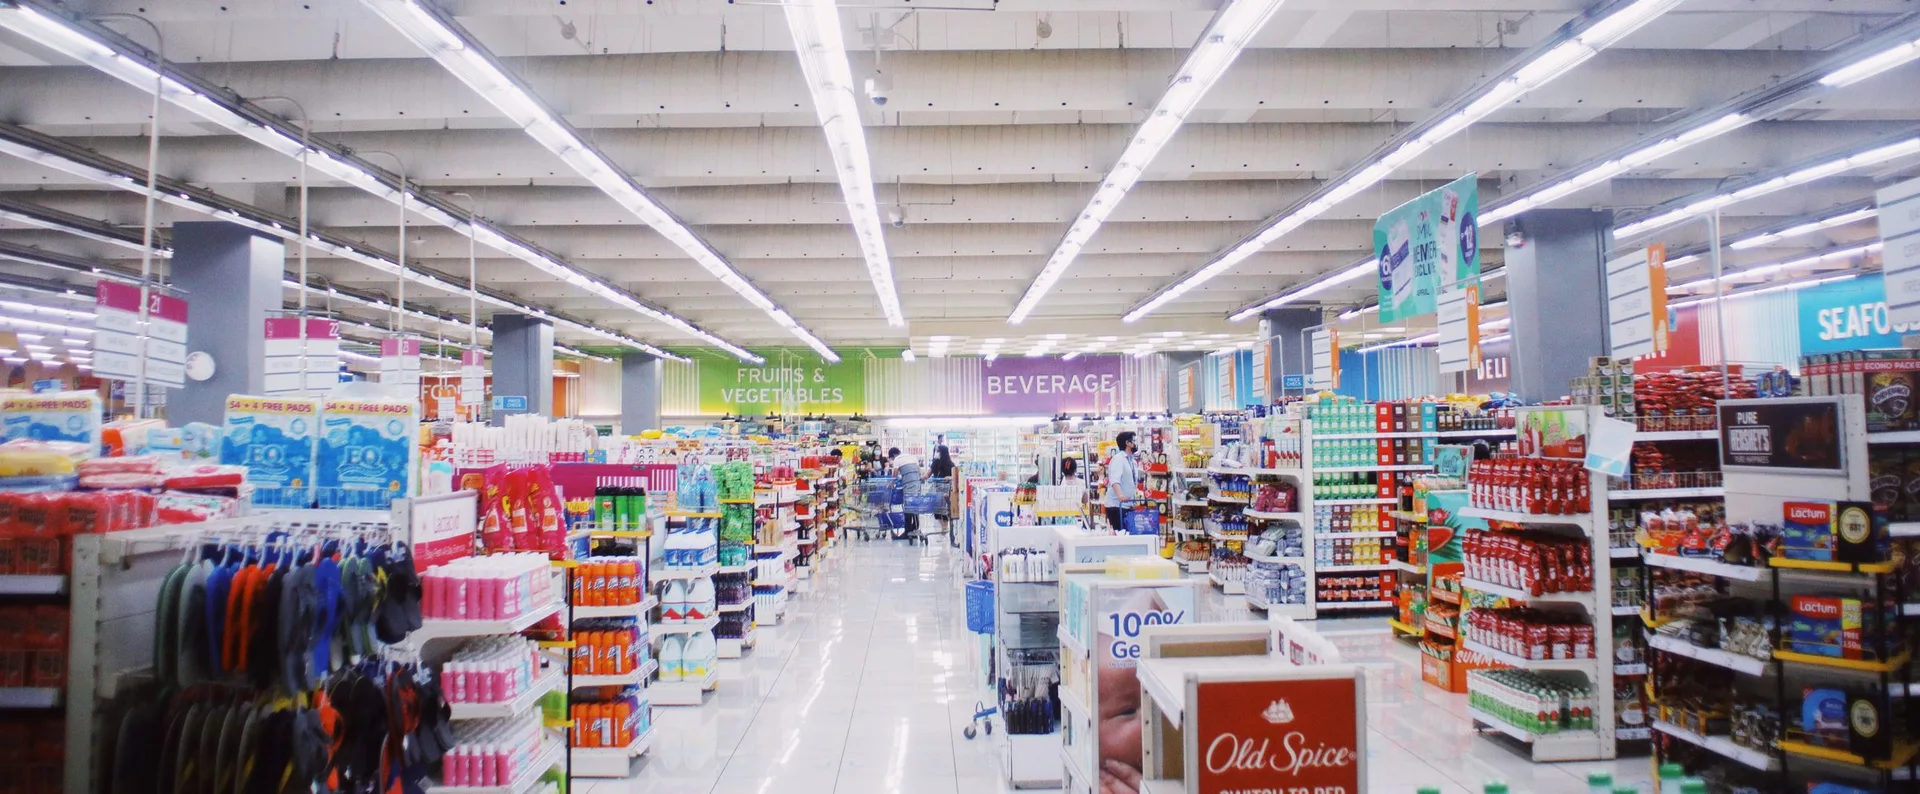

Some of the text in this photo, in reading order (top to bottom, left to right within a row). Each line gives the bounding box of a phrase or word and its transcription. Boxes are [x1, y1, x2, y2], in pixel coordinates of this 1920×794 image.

[1818, 301, 1920, 341] SEAFO
[329, 322, 339, 337] 22
[1477, 357, 1507, 381] DELI
[1864, 362, 1893, 370] ECONO
[738, 367, 825, 383] FRUITS &
[987, 373, 1114, 394] BEVERAGE
[722, 387, 843, 404] VEGETABLES
[36, 400, 58, 409] FREE
[61, 400, 88, 409] PADS
[262, 402, 283, 412] FREE
[286, 402, 312, 413] PADS
[358, 403, 380, 413] FREE
[383, 404, 408, 414] PADS
[1736, 411, 1758, 425] PURE
[247, 443, 287, 466] EQ
[344, 445, 384, 467] EQ
[1790, 507, 1826, 519] Lactum
[1800, 601, 1837, 614] Lactum
[1109, 610, 1185, 638] 100%
[1206, 732, 1269, 774] Old
